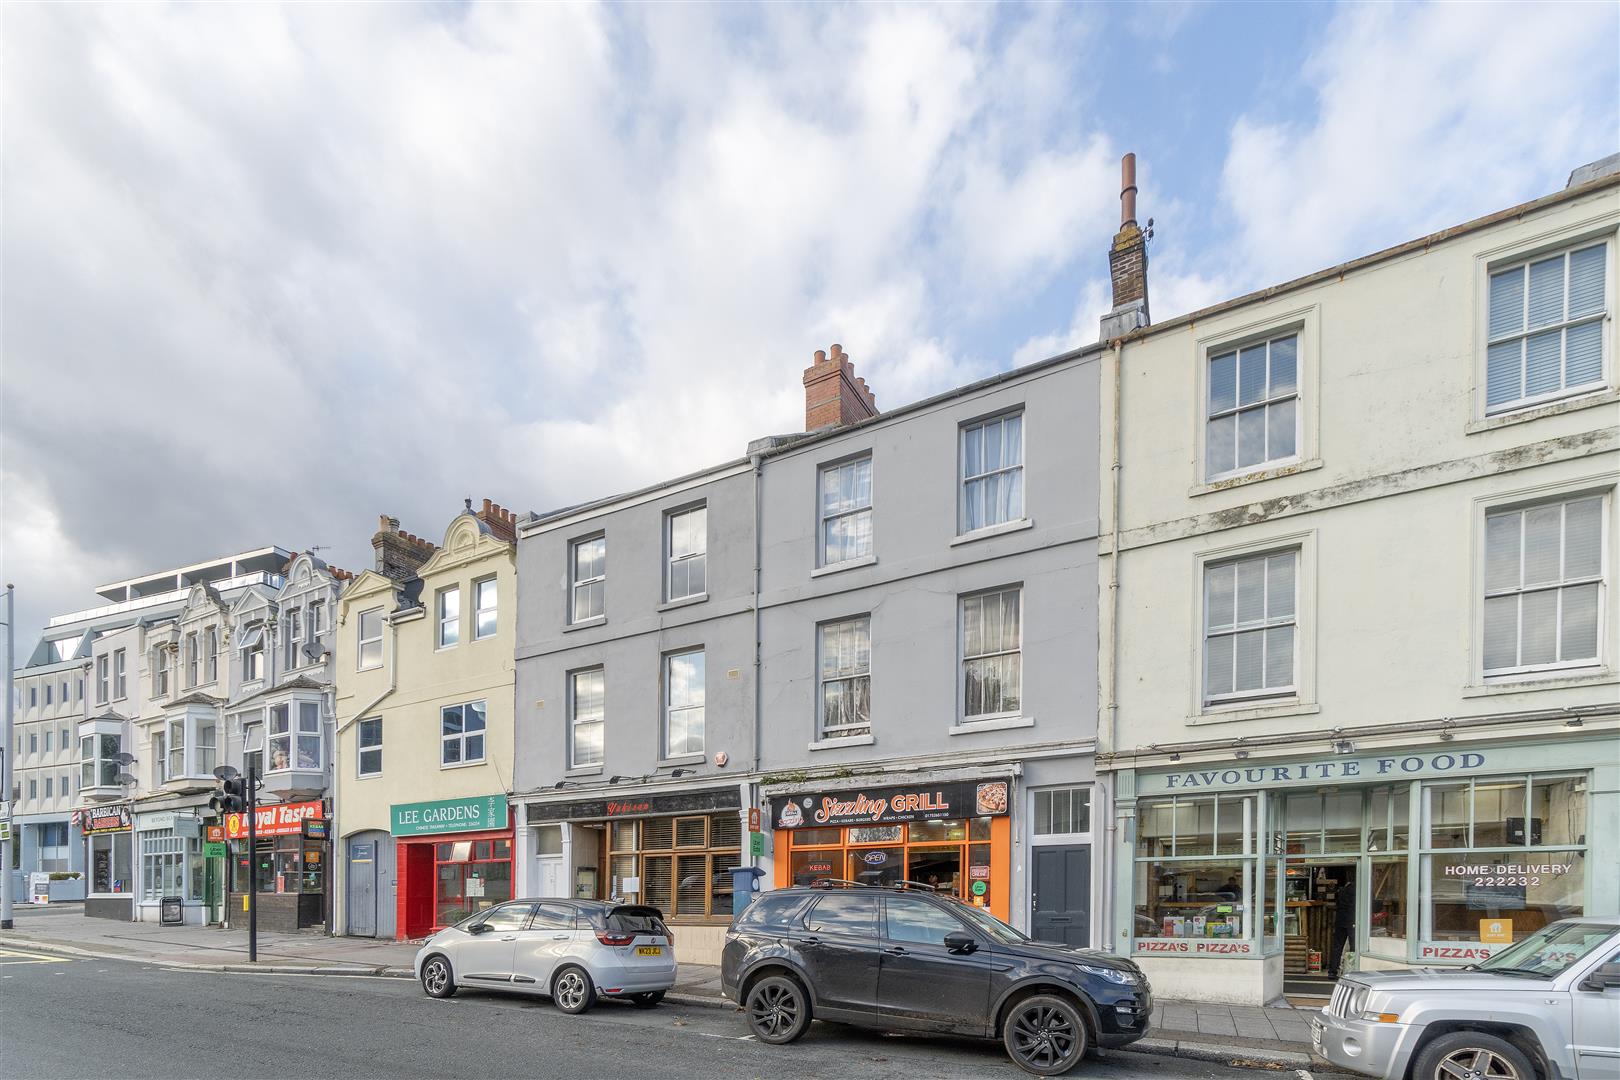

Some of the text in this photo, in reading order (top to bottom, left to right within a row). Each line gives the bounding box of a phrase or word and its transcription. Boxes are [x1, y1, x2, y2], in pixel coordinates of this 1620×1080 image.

[1166, 753, 1485, 789] FAVOURITE FOOD
[279, 800, 315, 824] Taste
[814, 791, 949, 823] Sizzling GRILL
[399, 804, 480, 824] LEE GARDENS
[864, 853, 886, 862] OPEN
[1445, 864, 1572, 875] HOME DELIVERY
[1474, 876, 1540, 887] 222232
[1137, 942, 1250, 953] PIZZA'S PIZZA'S
[1422, 947, 1491, 959] PIZZA'S
